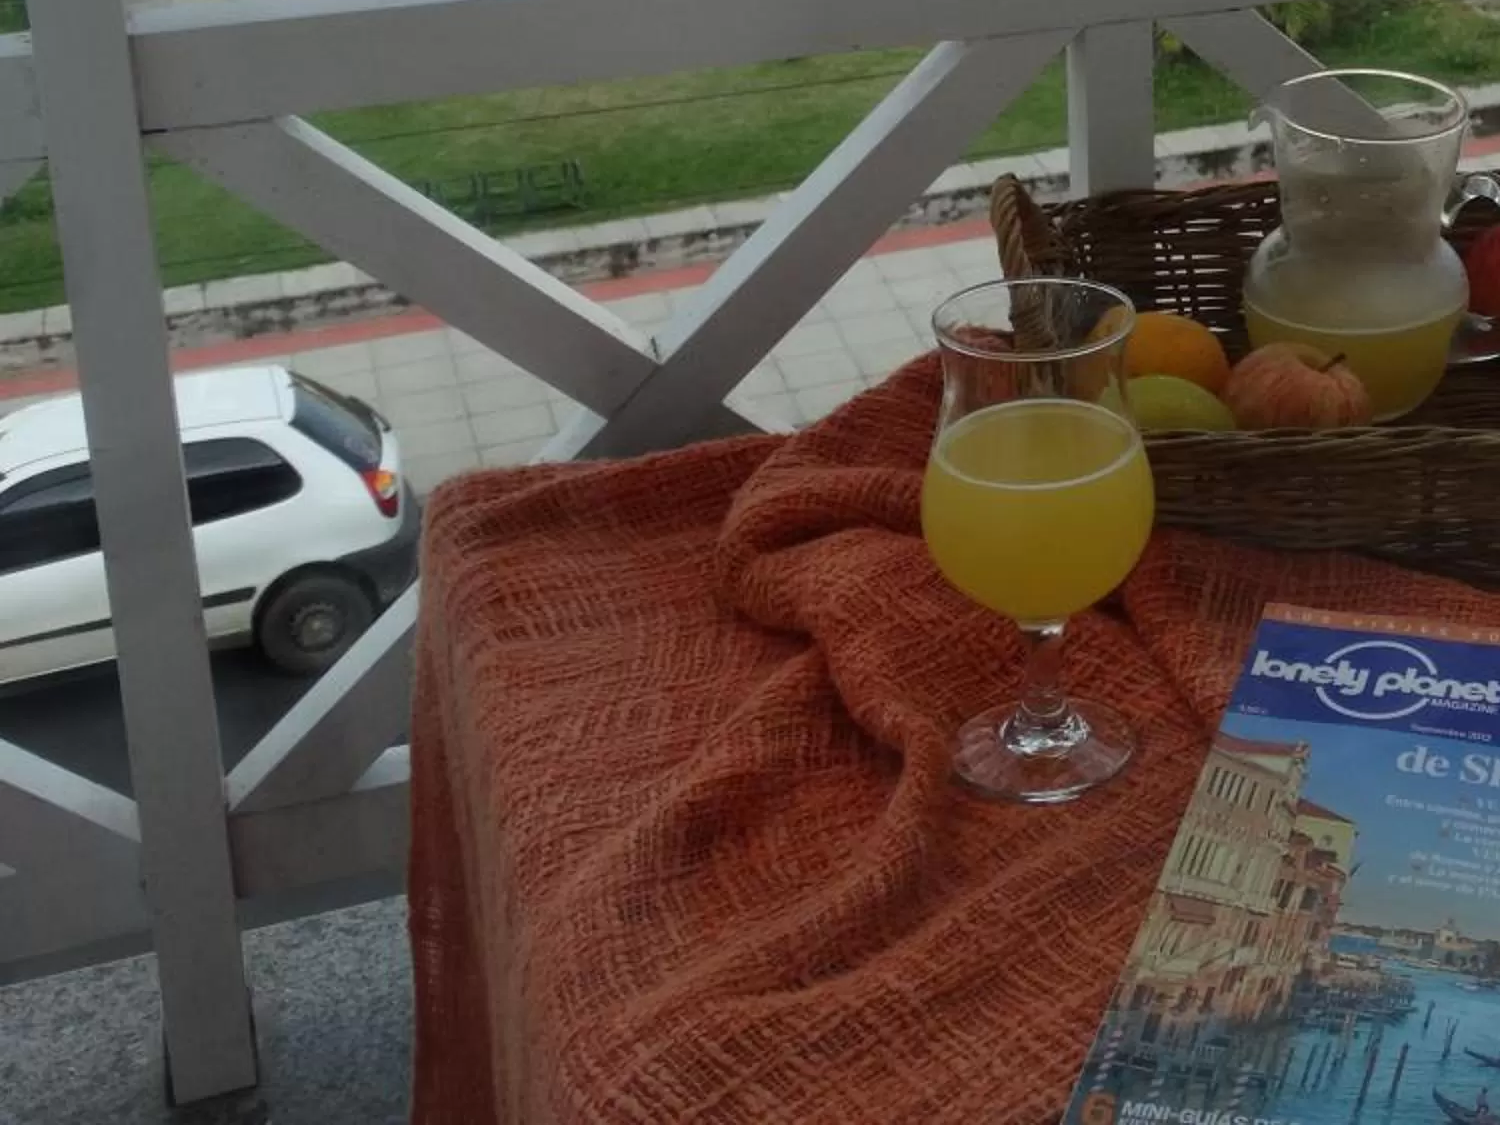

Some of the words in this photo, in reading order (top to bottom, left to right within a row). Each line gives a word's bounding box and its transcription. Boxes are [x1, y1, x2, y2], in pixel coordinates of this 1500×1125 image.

[1251, 650, 1369, 695] lonely
[1430, 697, 1500, 715] MAGAZINE
[1396, 744, 1450, 778] de
[1081, 1090, 1116, 1125] 6
